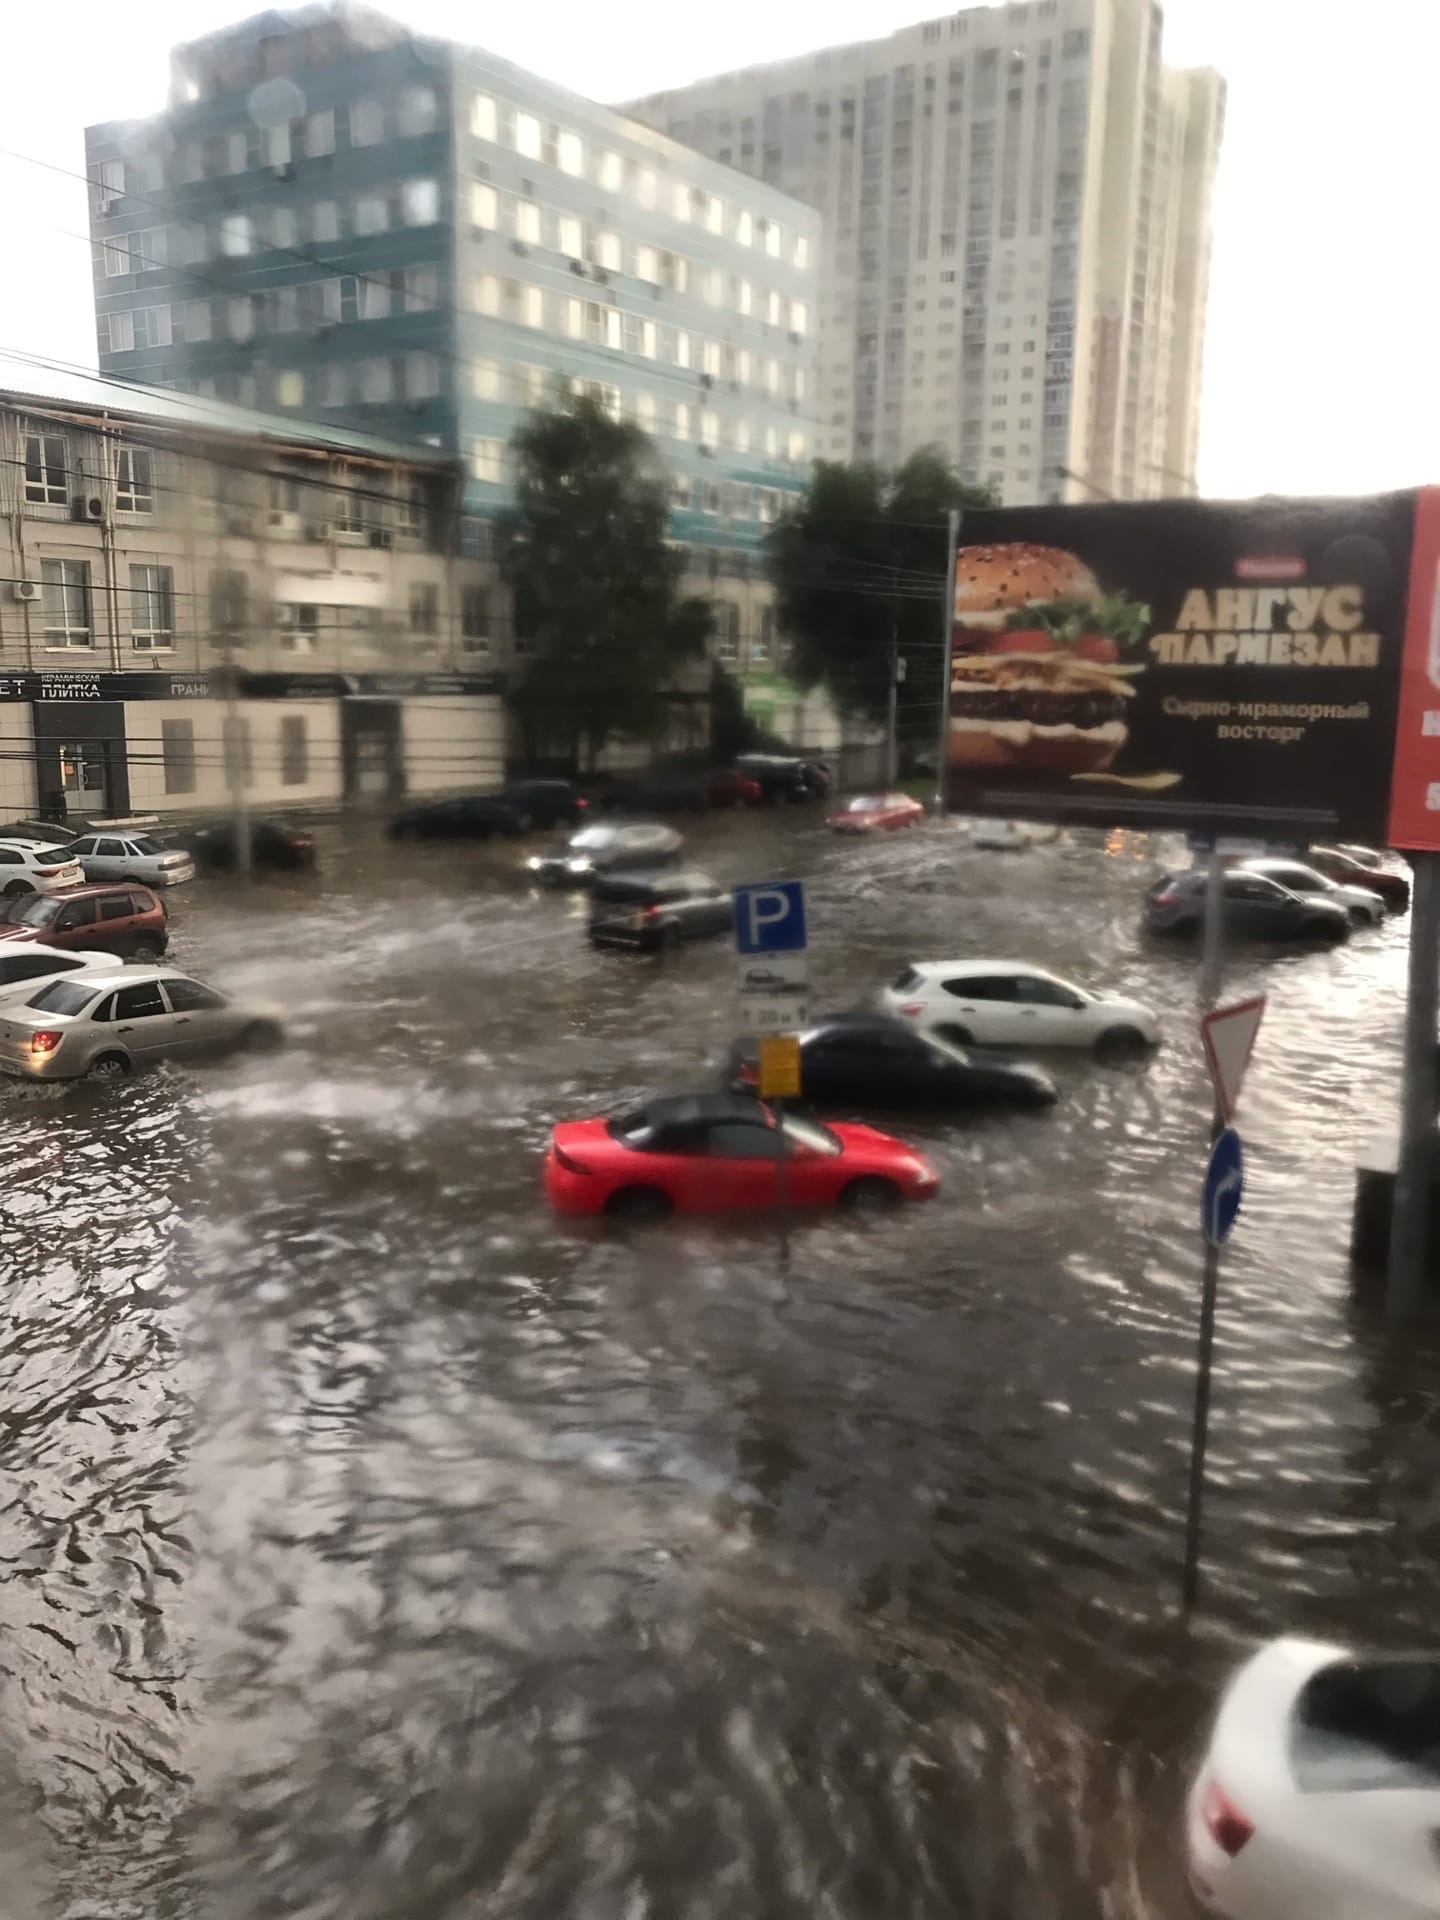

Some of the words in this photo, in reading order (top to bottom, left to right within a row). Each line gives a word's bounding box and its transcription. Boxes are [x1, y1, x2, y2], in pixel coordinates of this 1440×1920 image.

[1175, 584, 1364, 631] АНГУС
[1149, 632, 1382, 667] ПАРМЕЗАН
[41, 684, 101, 697] ПЛИТКА
[1162, 696, 1370, 721] Сырно-мраморный
[1217, 725, 1306, 744] восторг
[748, 890, 790, 946] P
